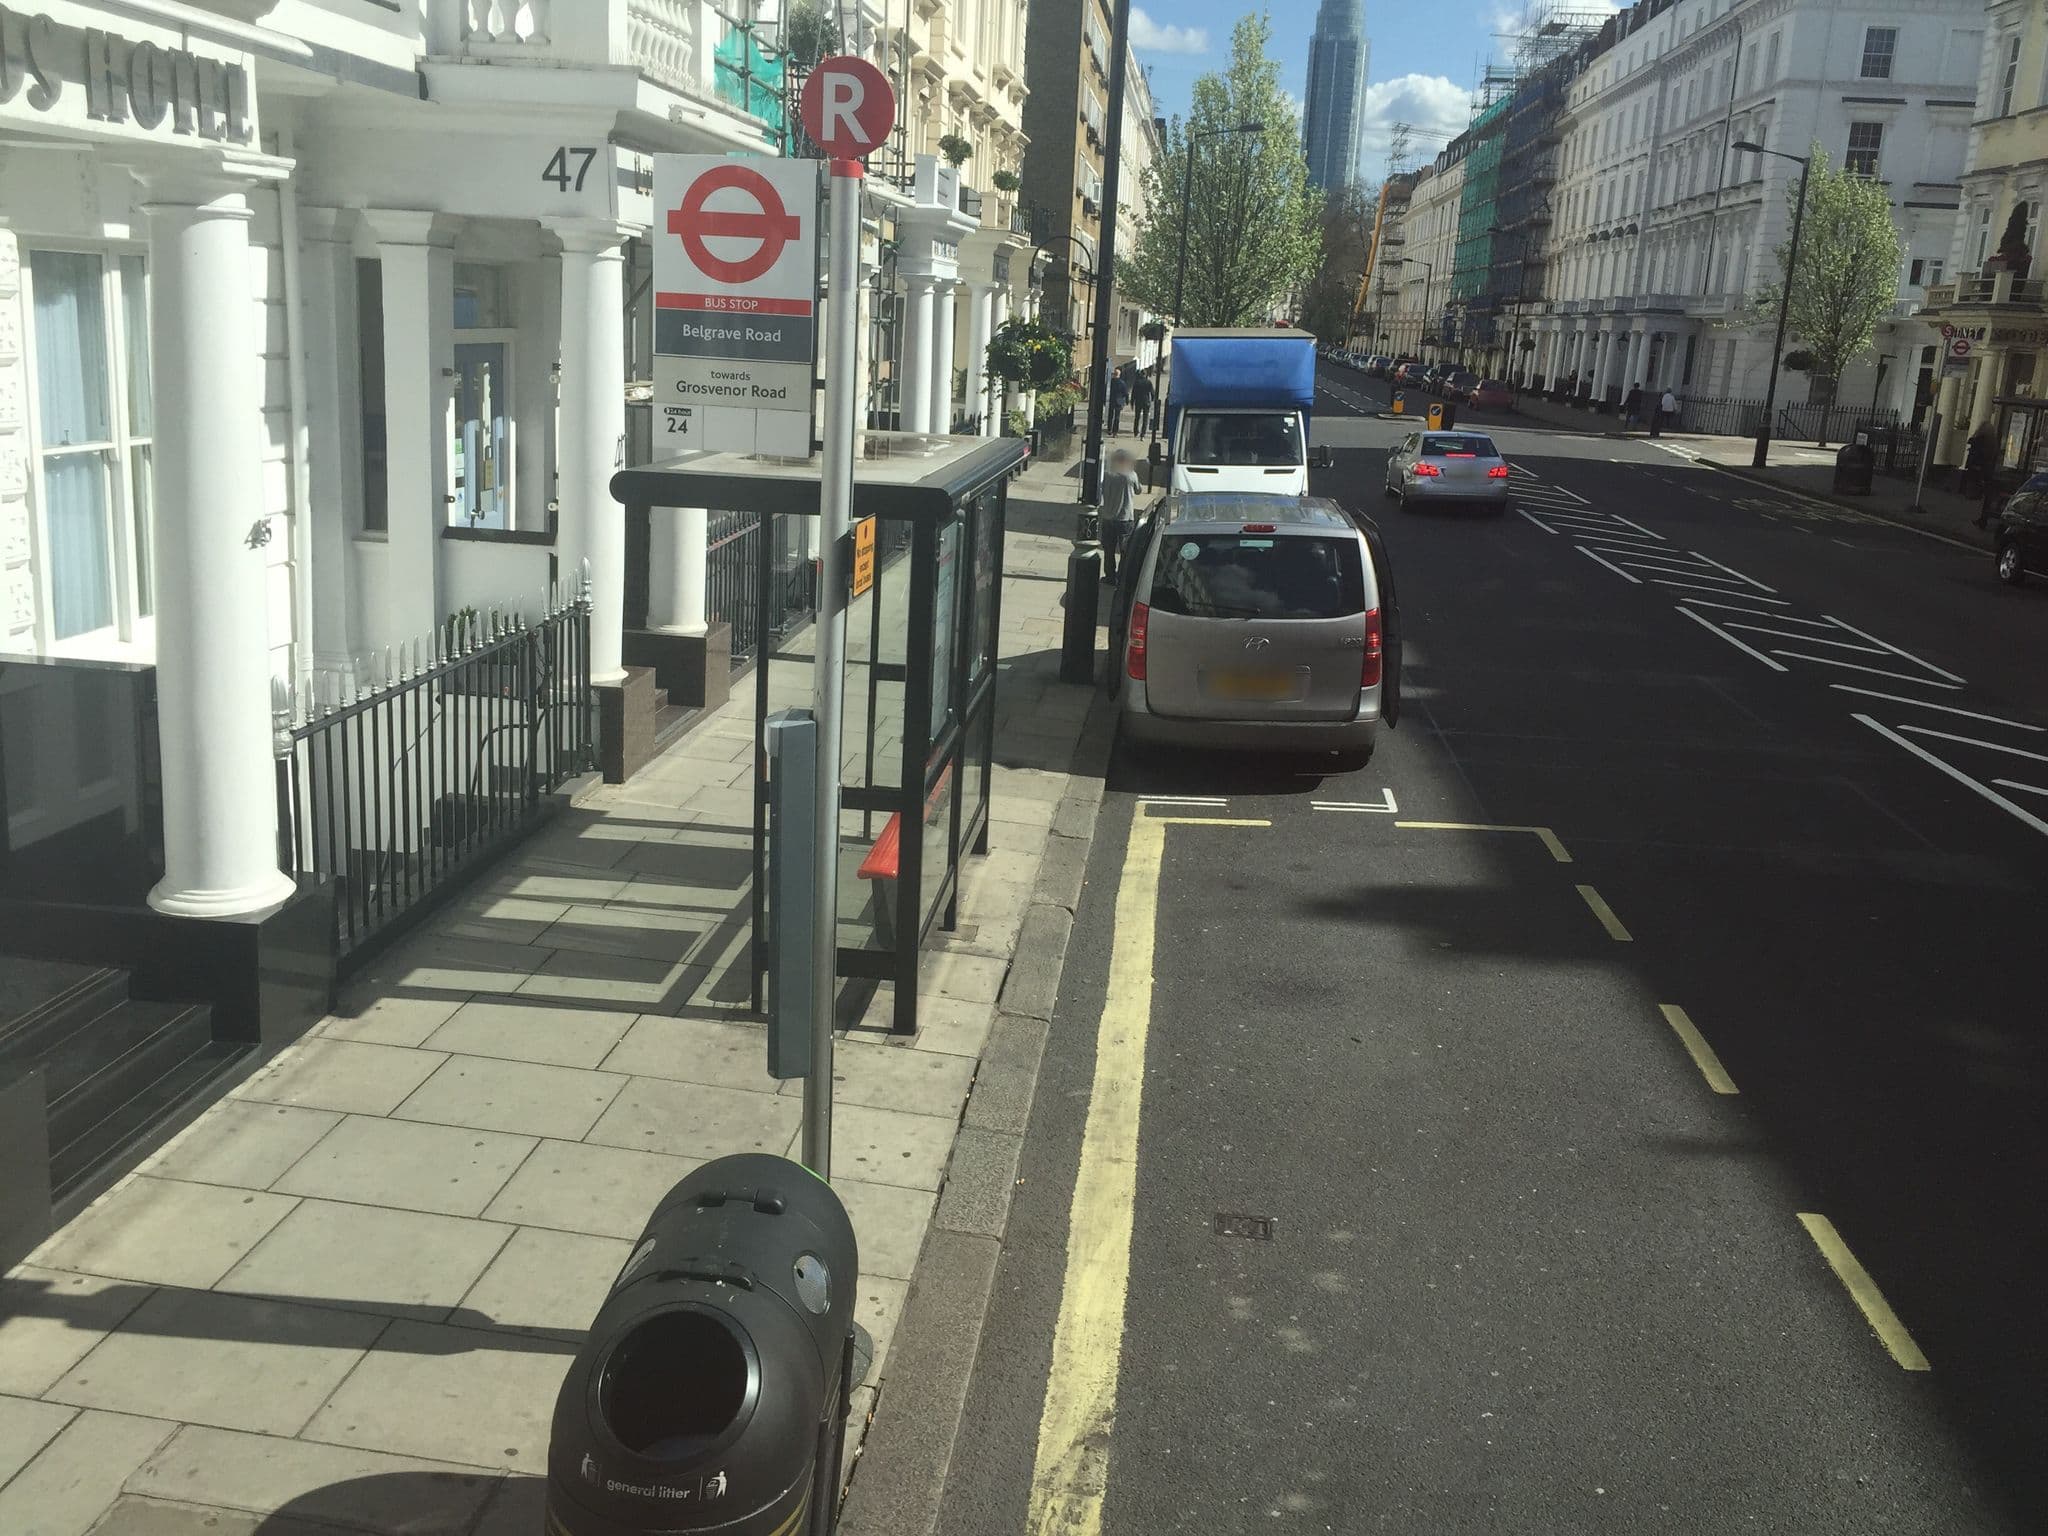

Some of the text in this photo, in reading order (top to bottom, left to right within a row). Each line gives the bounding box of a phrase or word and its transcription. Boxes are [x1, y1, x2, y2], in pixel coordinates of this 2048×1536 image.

[86, 27, 254, 146] HOTEL
[821, 71, 872, 144] R
[542, 146, 597, 192] 47
[704, 297, 759, 310] BUS STOP
[682, 324, 782, 342] Belgrave Road
[676, 370, 787, 399] towards Grosvenor Road
[667, 417, 688, 434] 24
[606, 1478, 690, 1499] general litter
